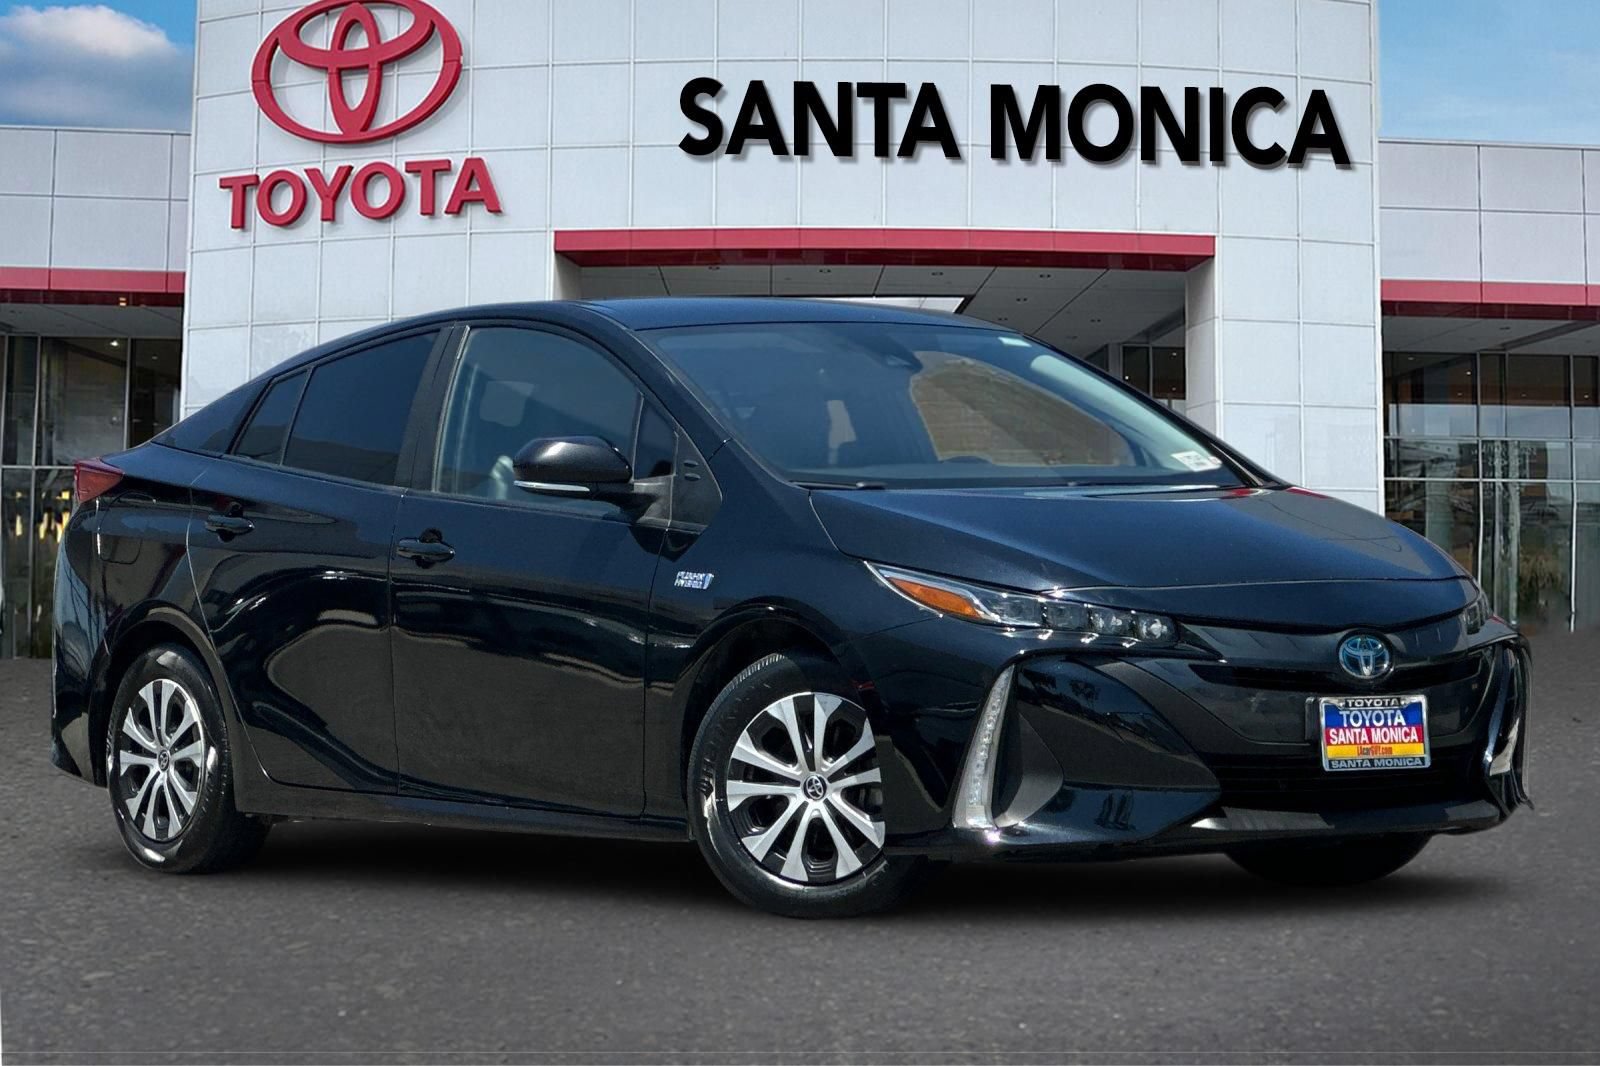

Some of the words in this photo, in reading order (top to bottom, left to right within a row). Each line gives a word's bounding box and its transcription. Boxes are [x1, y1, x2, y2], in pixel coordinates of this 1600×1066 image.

[678, 77, 962, 159] SANTA
[989, 83, 1351, 169] MONICA
[219, 157, 502, 229] TOYOTA
[1346, 698, 1399, 707] TOYOTA
[1339, 710, 1406, 727] TOYOTA
[1329, 728, 1369, 745] SANTA
[1371, 727, 1419, 744] MONICA
[1331, 758, 1372, 769] SANTA
[1374, 757, 1423, 768] MONICA
